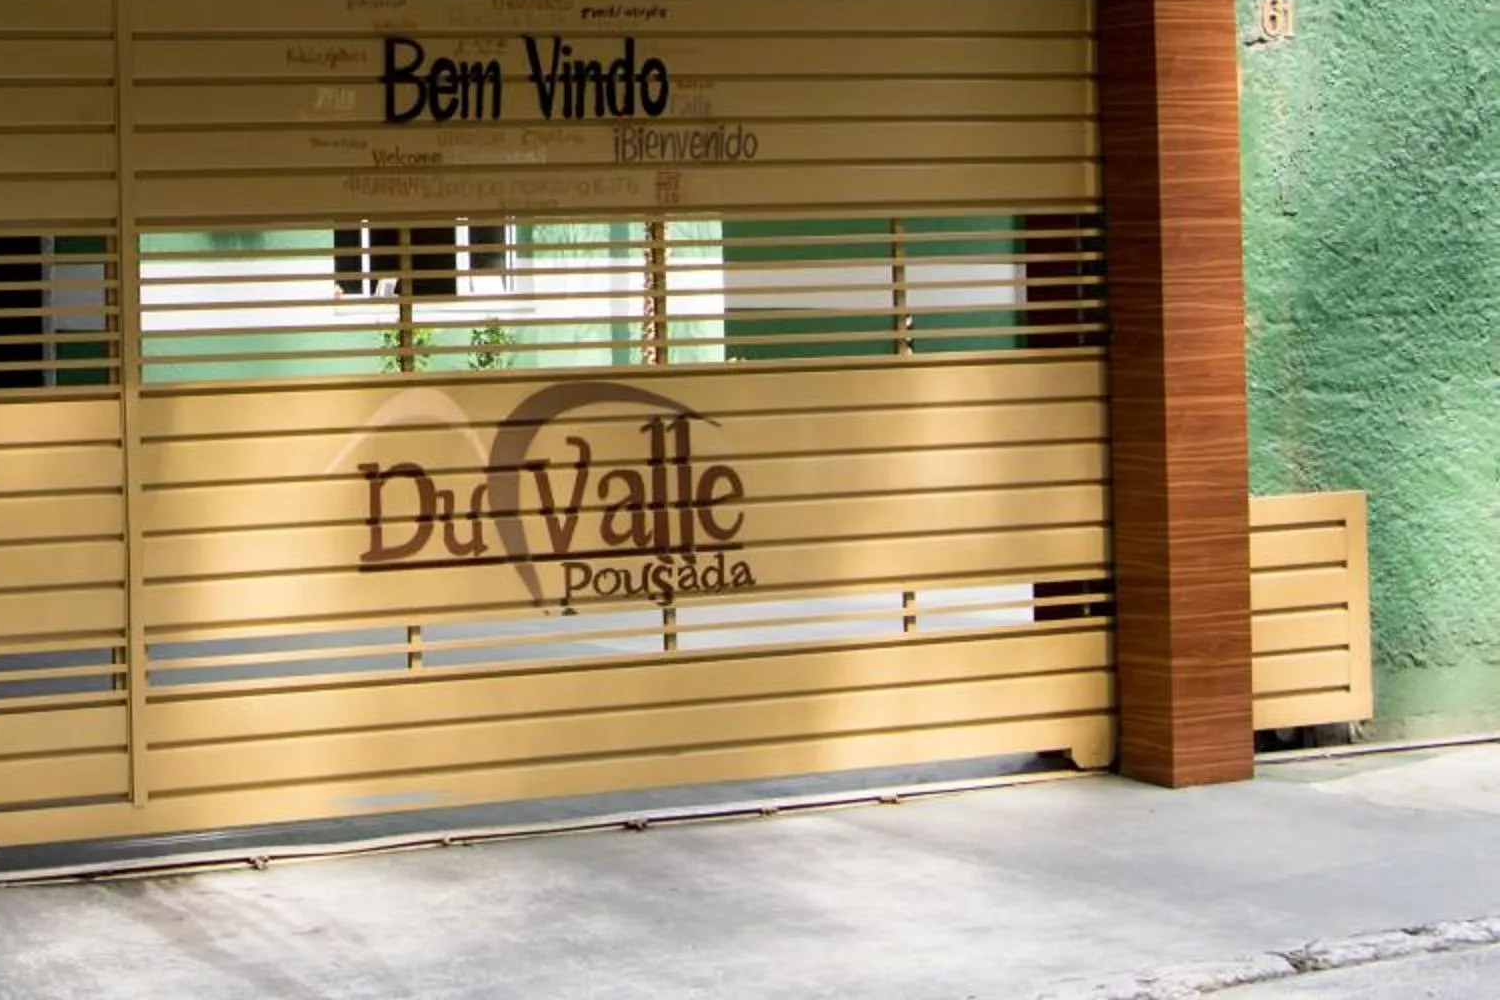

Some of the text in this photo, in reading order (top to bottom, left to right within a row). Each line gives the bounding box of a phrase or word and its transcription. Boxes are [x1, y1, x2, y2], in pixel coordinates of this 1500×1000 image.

[383, 34, 670, 124] Bem Vindo
[370, 144, 444, 167] Welcome
[560, 551, 757, 615] Pousada
